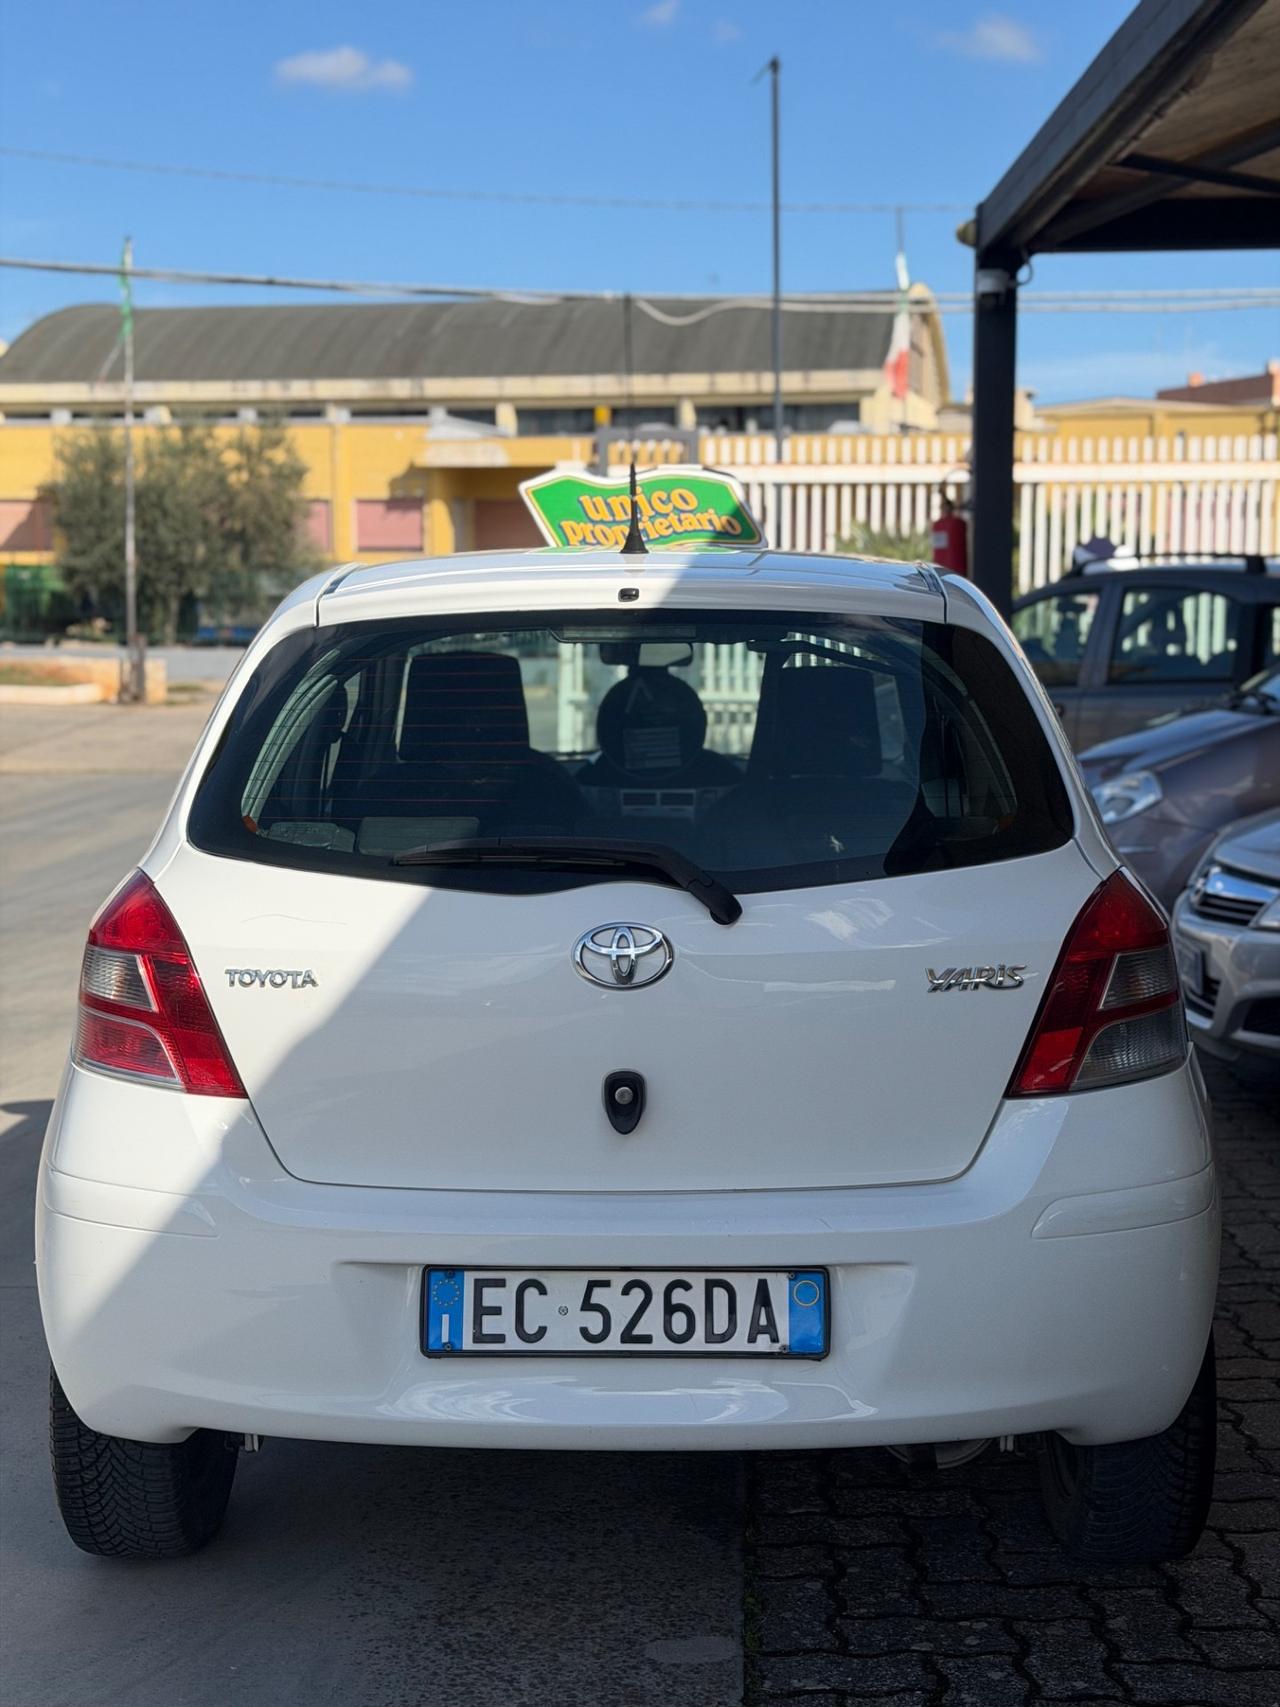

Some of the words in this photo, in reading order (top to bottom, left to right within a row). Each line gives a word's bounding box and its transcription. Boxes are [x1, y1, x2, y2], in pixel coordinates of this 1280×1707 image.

[224, 969, 319, 989] TOYOTA
[472, 1278, 548, 1344] EC
[579, 1278, 780, 1344] 526DA
